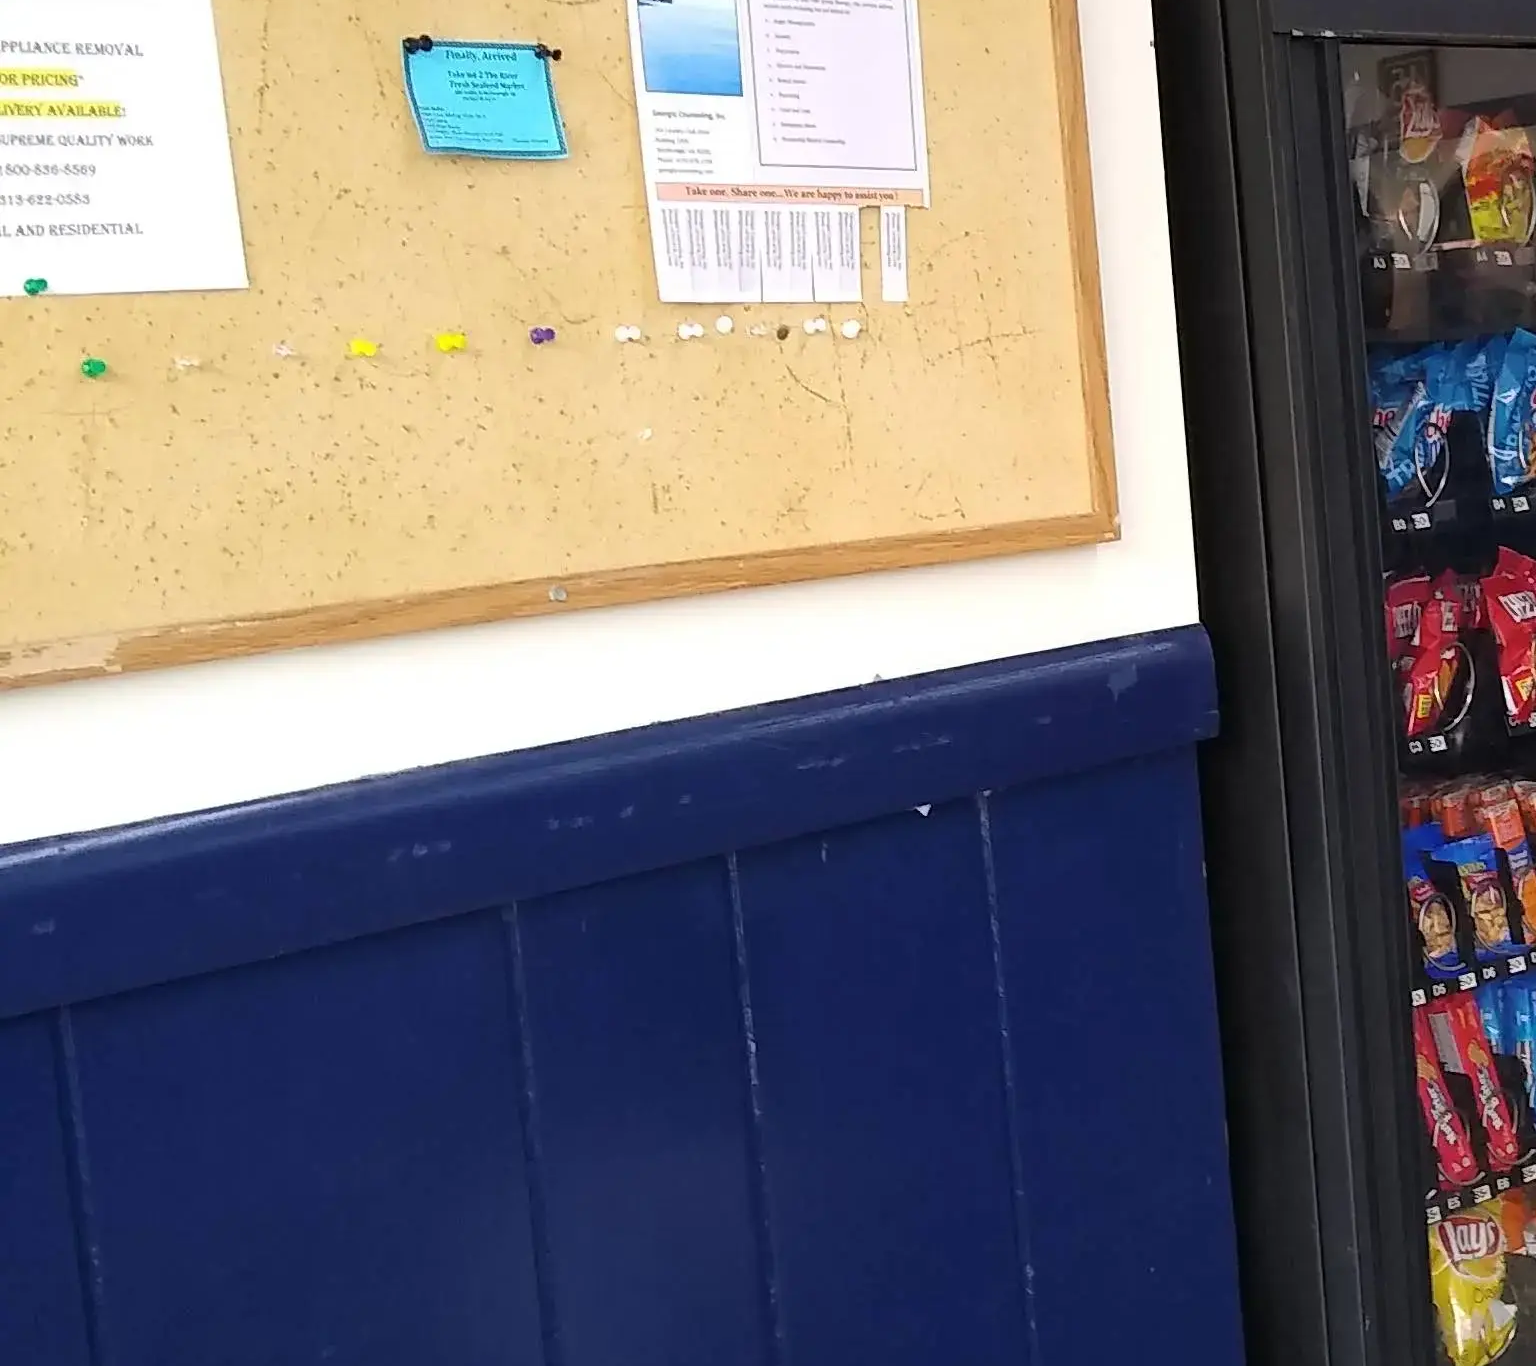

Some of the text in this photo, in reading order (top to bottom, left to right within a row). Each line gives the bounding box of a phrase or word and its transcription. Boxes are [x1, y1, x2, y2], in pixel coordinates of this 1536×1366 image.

[0, 40, 144, 57] PPLIANCE REMOVAL
[0, 134, 154, 147] UPREME QUALITY WORK
[686, 186, 707, 196] Take
[731, 188, 757, 197] Share
[784, 189, 798, 198] We
[801, 191, 815, 199] are
[817, 191, 842, 200] happy
[855, 192, 877, 200] assist
[16, 225, 45, 237] AND
[49, 223, 143, 236] RESIDENTIAL
